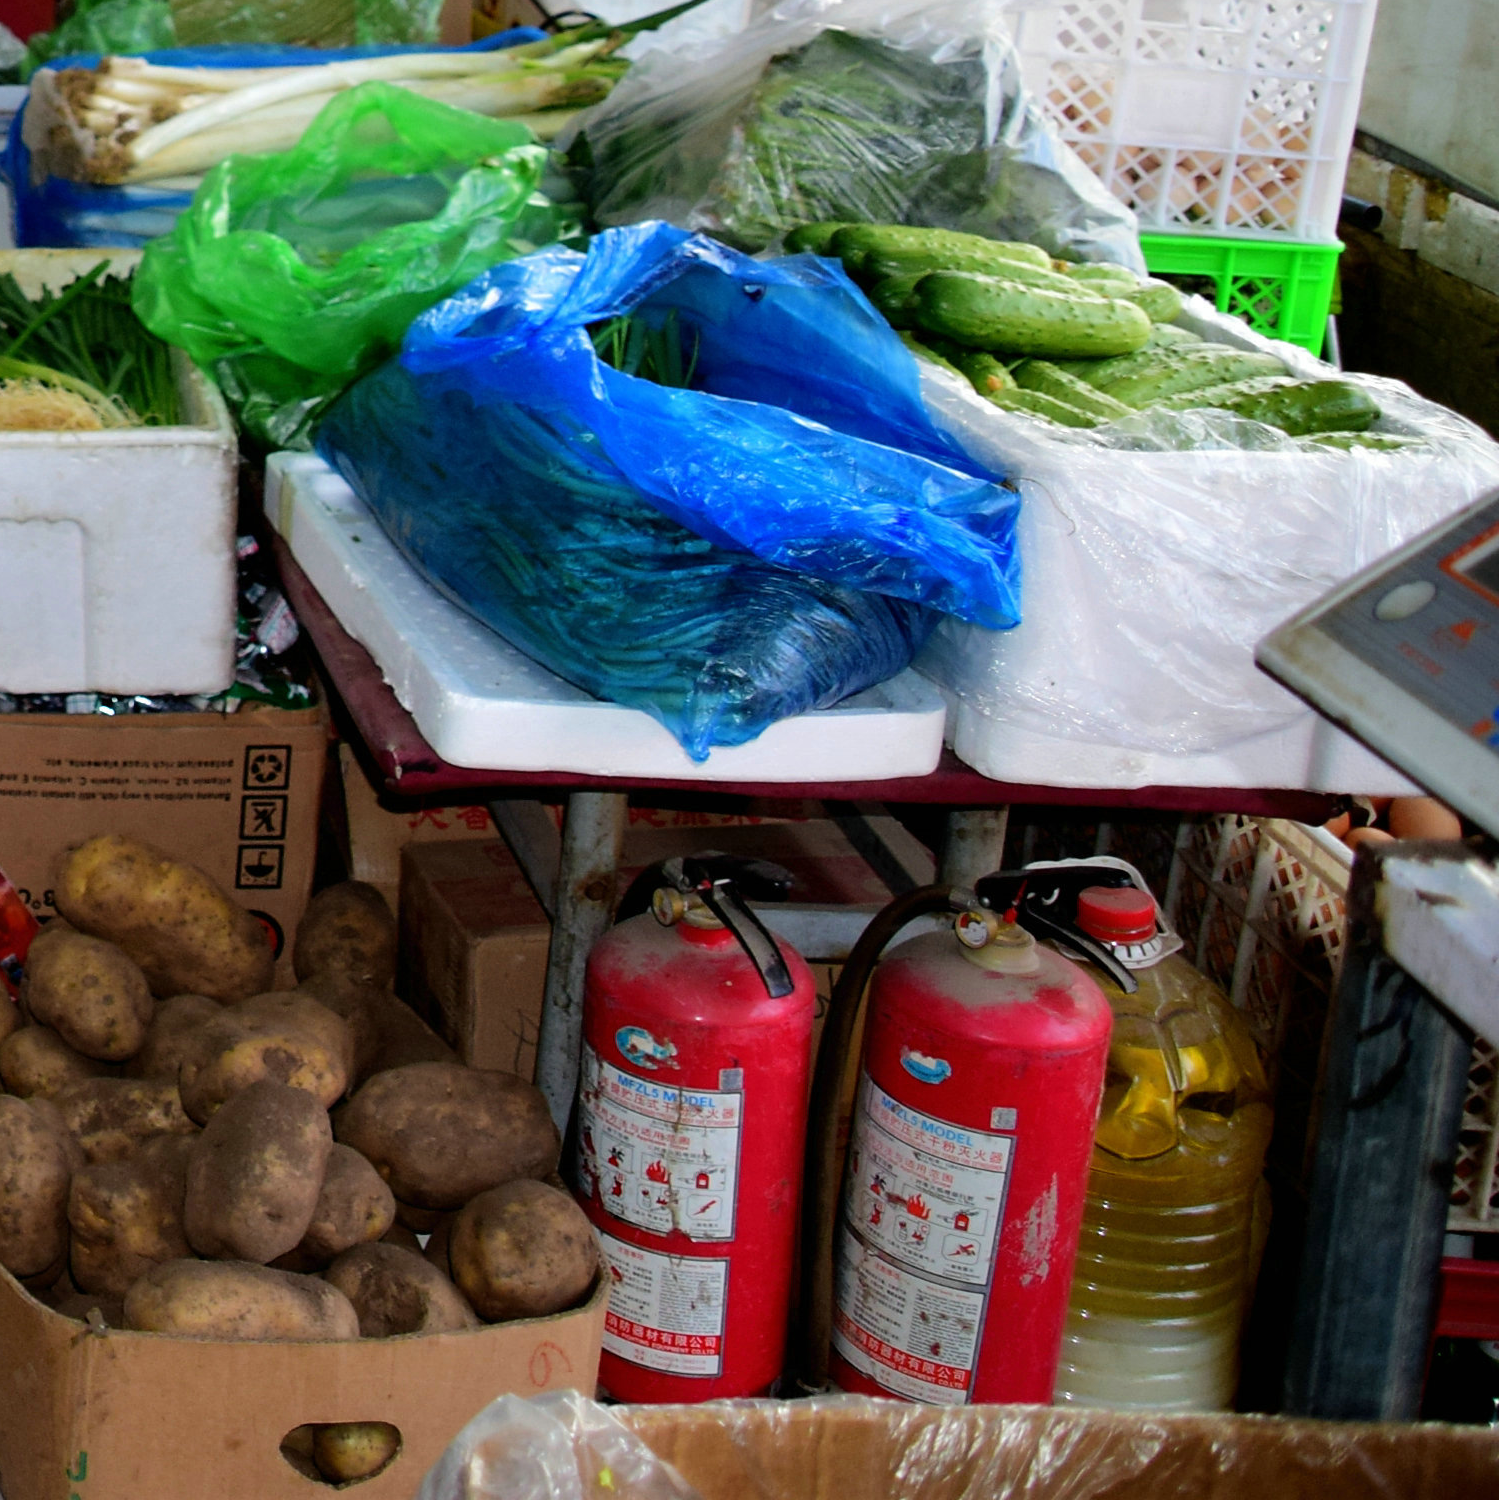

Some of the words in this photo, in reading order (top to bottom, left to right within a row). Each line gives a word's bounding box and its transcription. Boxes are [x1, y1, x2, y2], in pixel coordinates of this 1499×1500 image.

[617, 1074, 659, 1098] MFZL5
[662, 1090, 716, 1108] MODEL
[920, 1121, 974, 1147] MODEL
